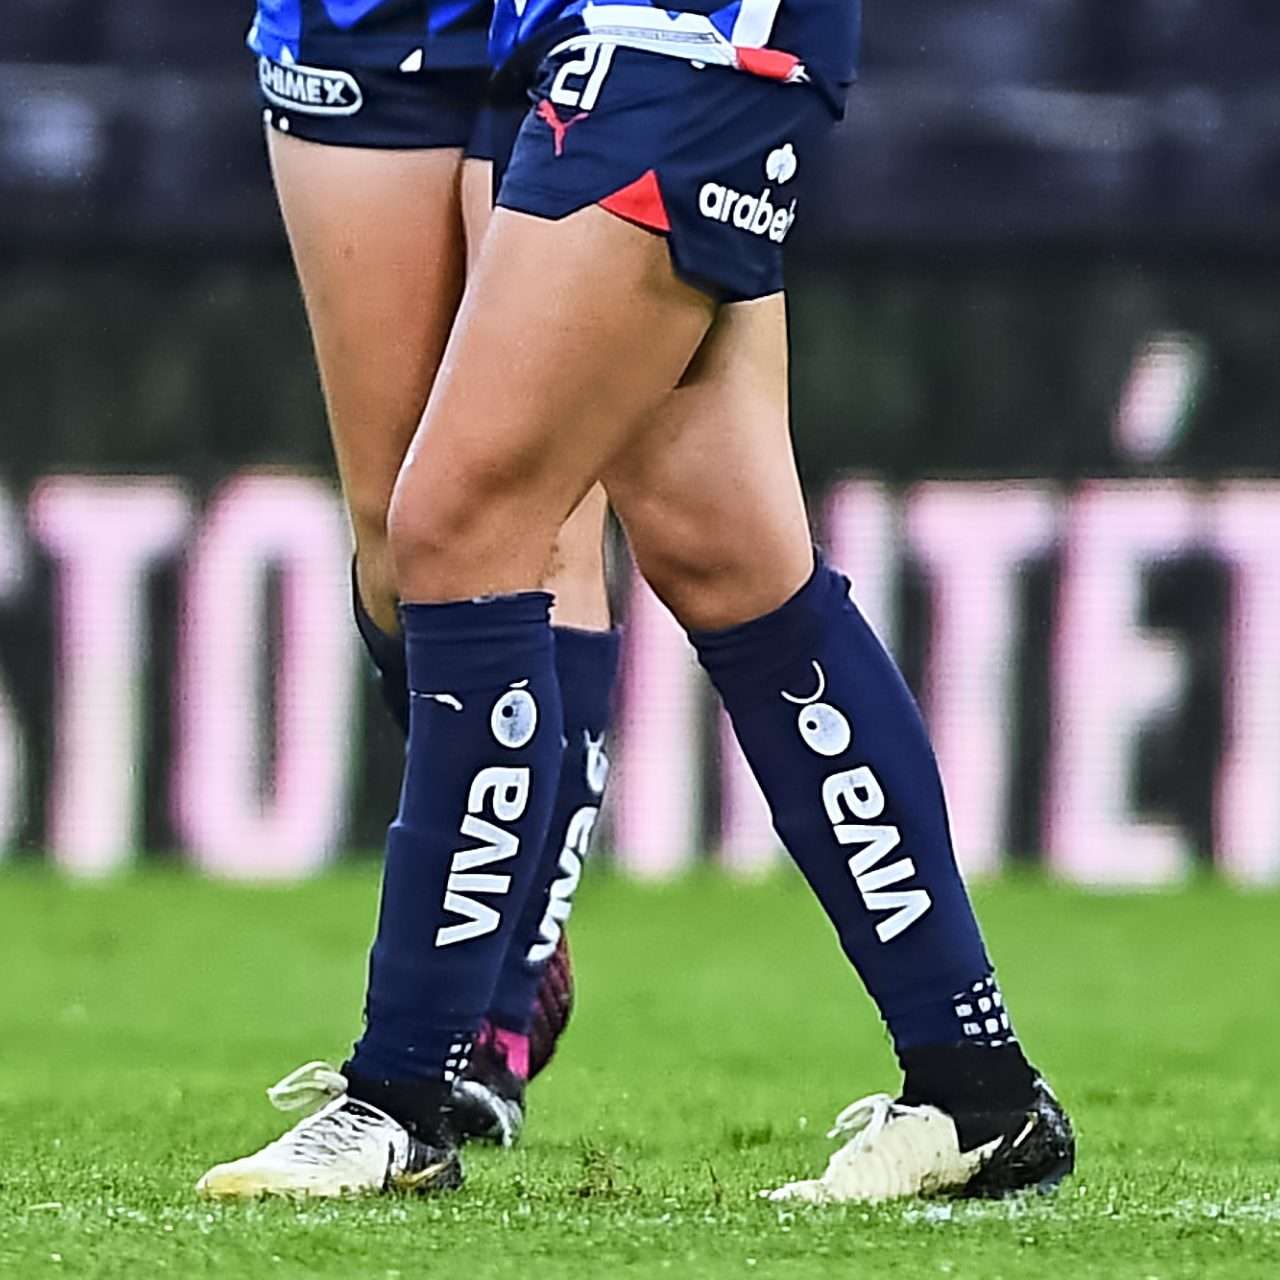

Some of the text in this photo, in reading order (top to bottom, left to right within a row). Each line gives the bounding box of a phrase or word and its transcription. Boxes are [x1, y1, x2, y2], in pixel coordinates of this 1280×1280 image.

[551, 42, 618, 111] 21
[436, 766, 531, 948] viva
[822, 765, 933, 945] viva
